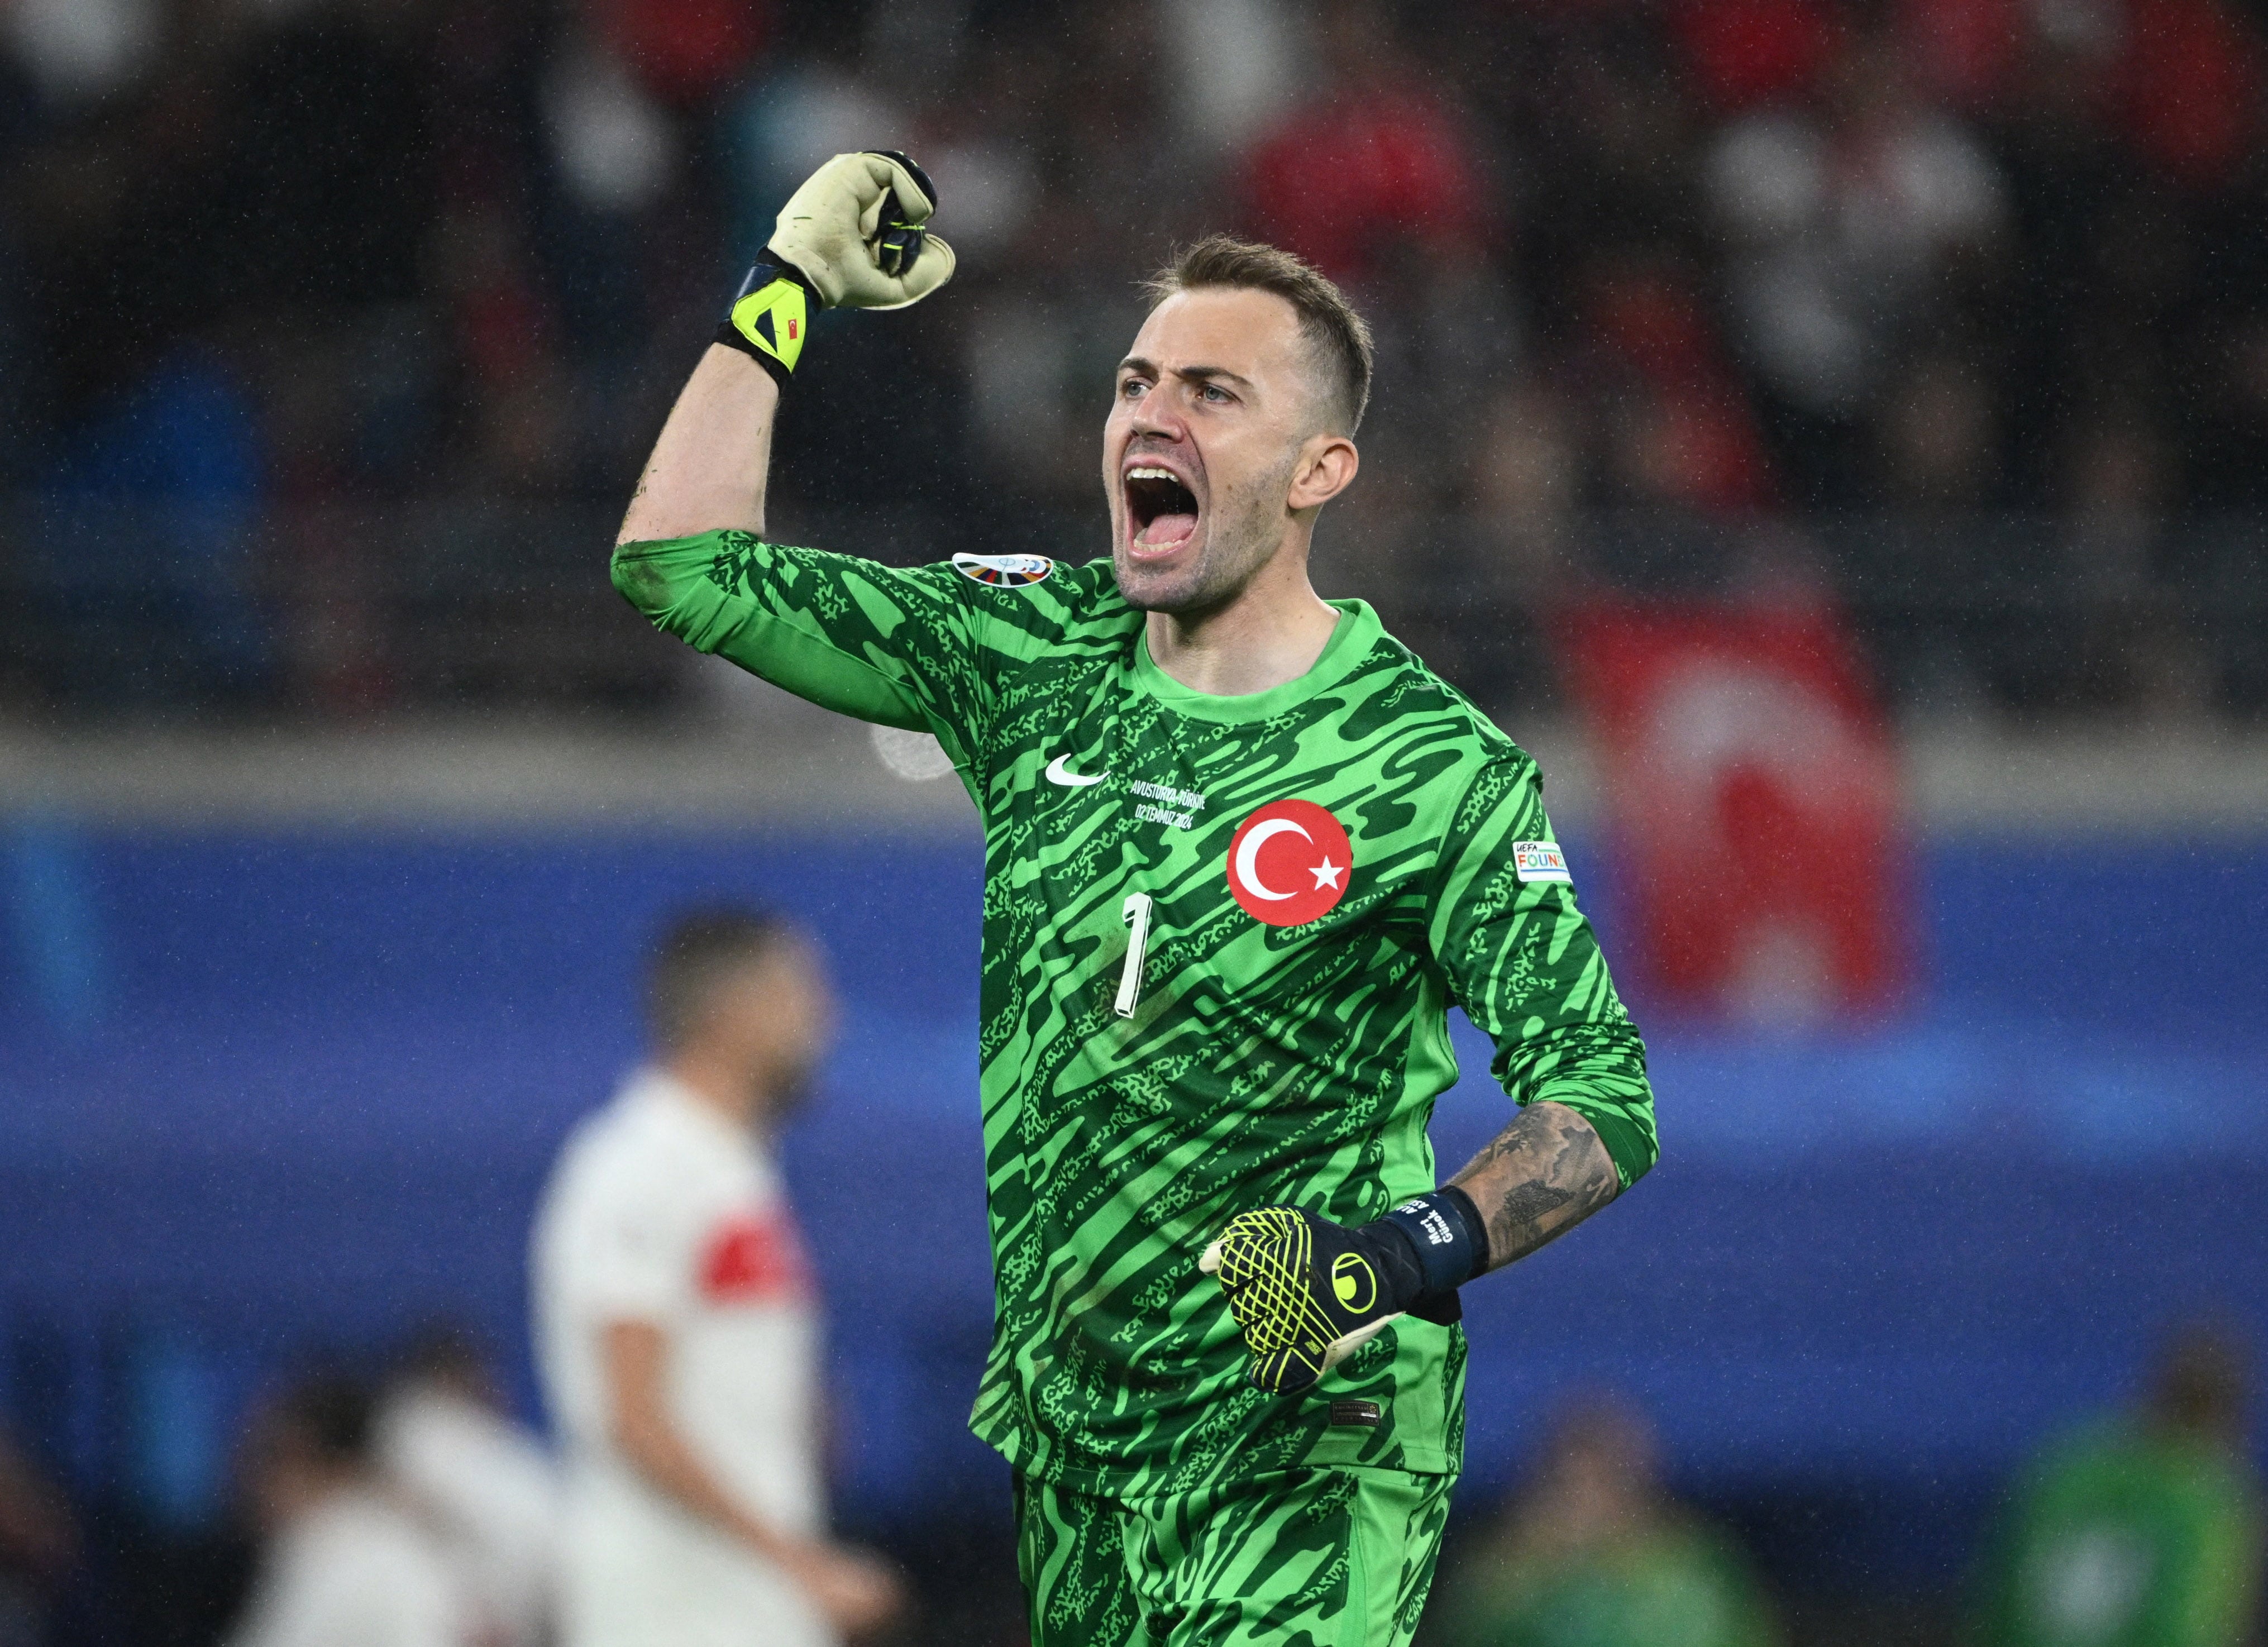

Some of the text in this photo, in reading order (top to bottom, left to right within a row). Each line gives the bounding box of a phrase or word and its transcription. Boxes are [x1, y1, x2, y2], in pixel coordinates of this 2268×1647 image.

[1135, 804, 1193, 829] 02 TEMMUZ 2024
[1517, 843, 1537, 852] UEFA
[1114, 891, 1153, 1019] 1
[1420, 1219, 1442, 1245] Mert
[1427, 1210, 1453, 1243] Günok
